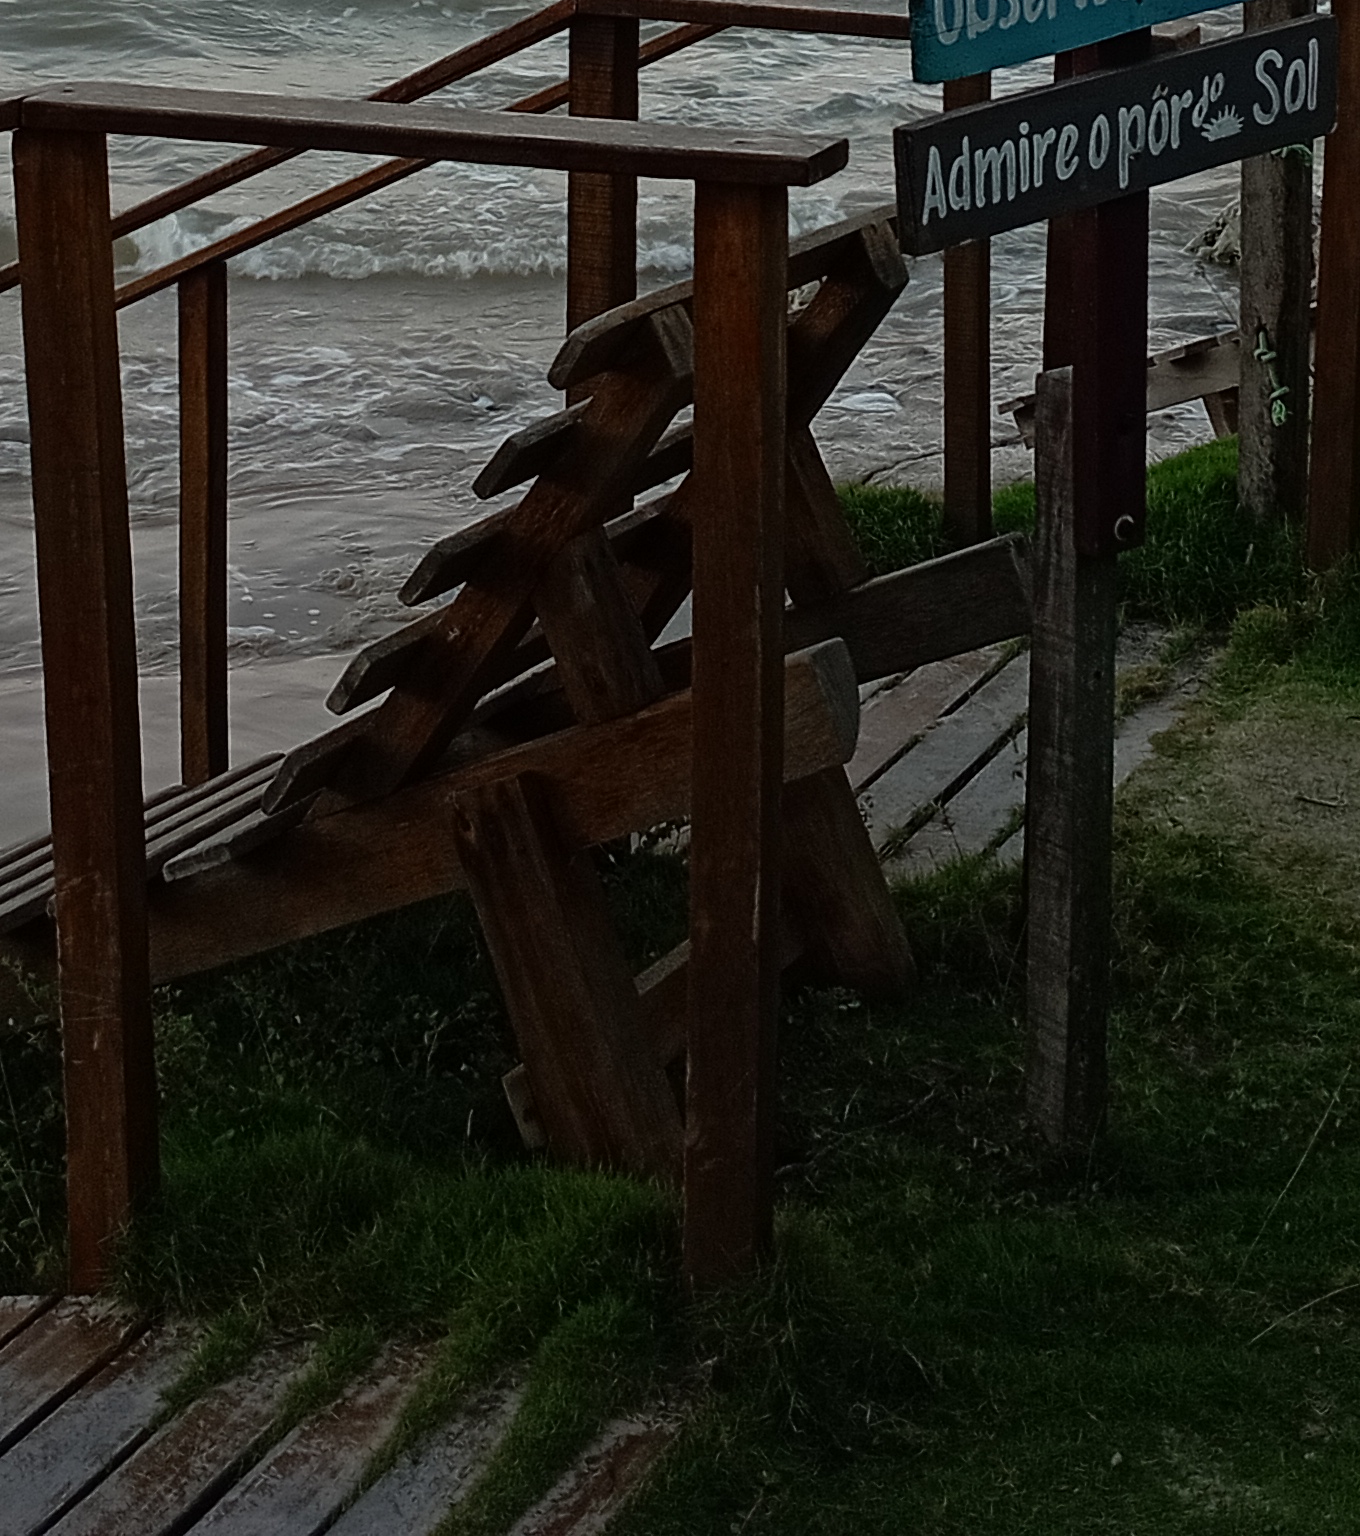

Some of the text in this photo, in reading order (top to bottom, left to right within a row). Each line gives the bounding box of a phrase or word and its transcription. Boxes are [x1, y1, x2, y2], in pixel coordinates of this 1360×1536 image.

[922, 116, 1079, 226] Admire
[1089, 114, 1110, 169] o
[1192, 72, 1225, 127] do
[1253, 37, 1319, 125] Sol
